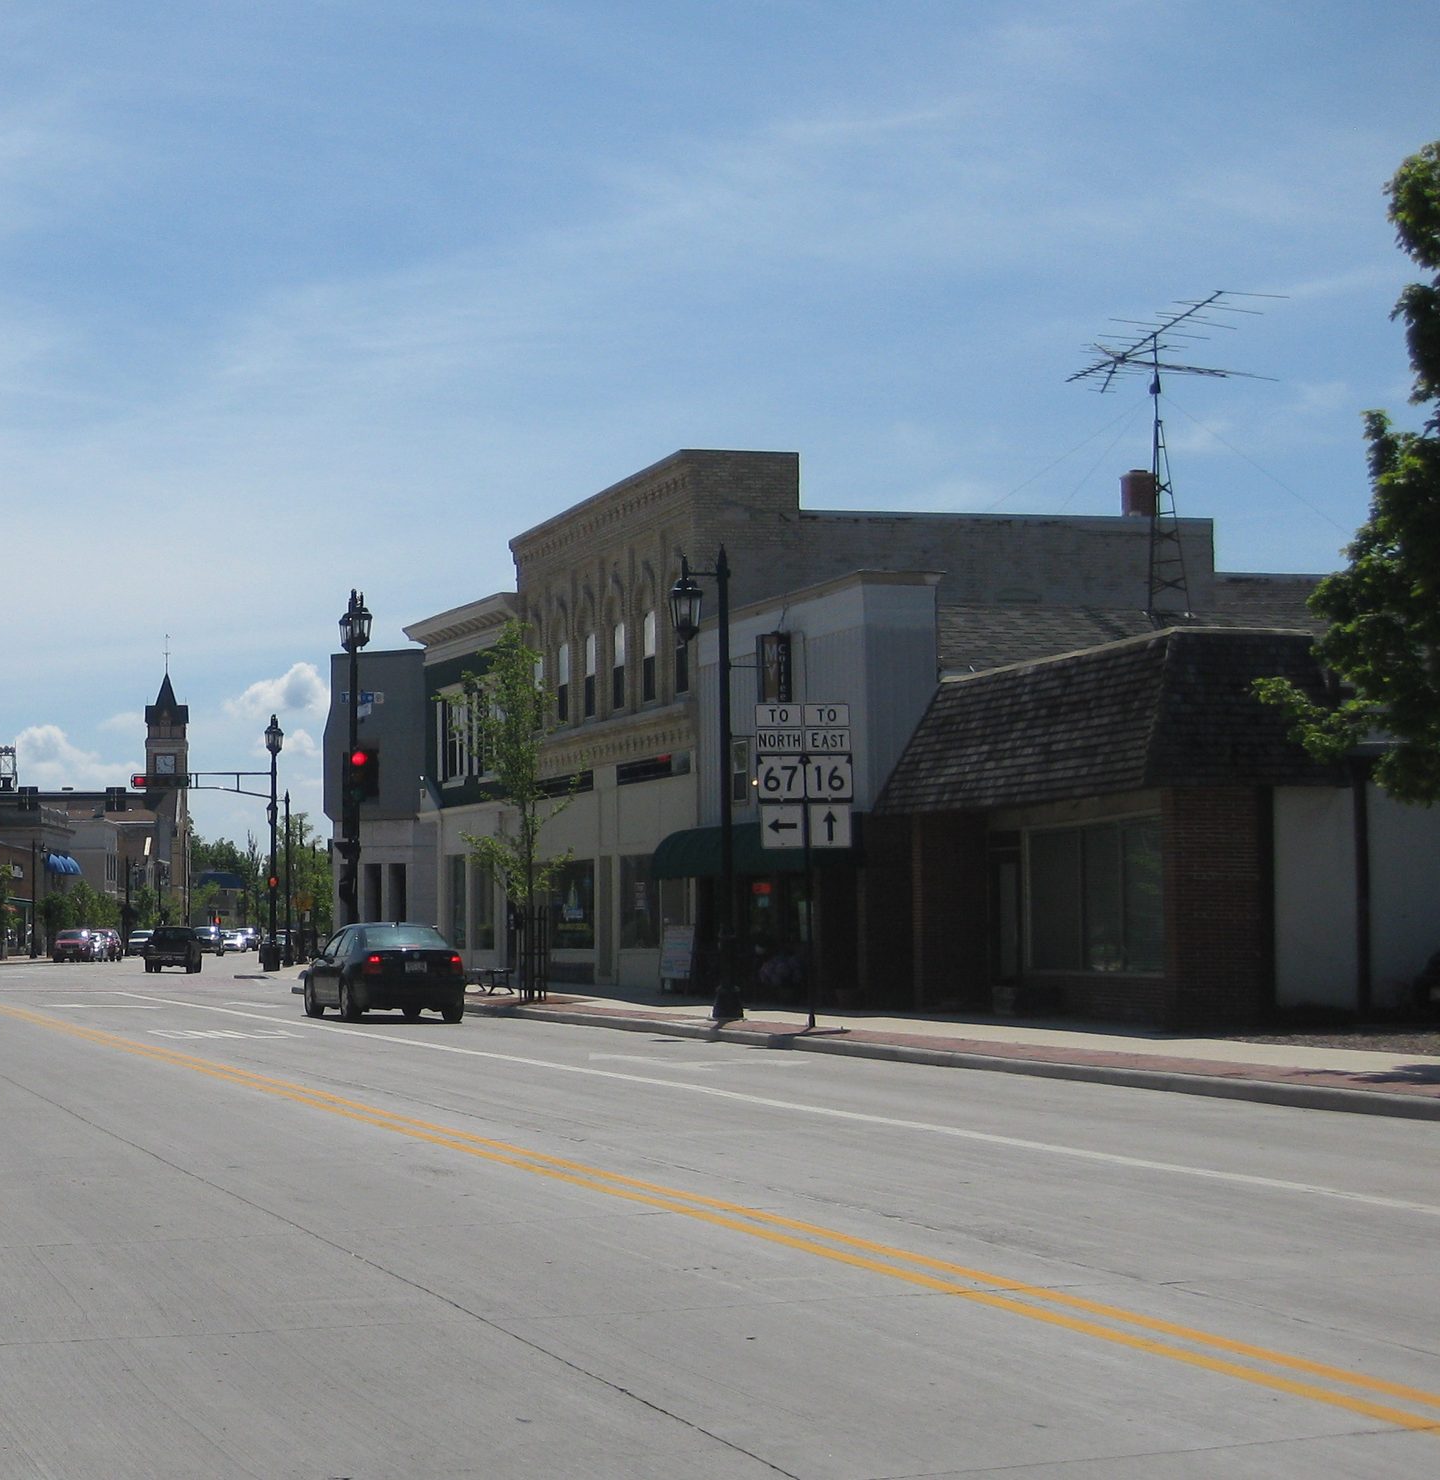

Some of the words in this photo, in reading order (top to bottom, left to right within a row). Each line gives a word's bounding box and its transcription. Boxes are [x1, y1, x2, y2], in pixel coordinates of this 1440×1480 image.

[769, 709, 789, 722] TO
[817, 709, 837, 722] TO
[758, 733, 801, 748] NORTH
[811, 732, 844, 748] EAST
[764, 766, 798, 792] 67
[814, 766, 844, 792] 16
